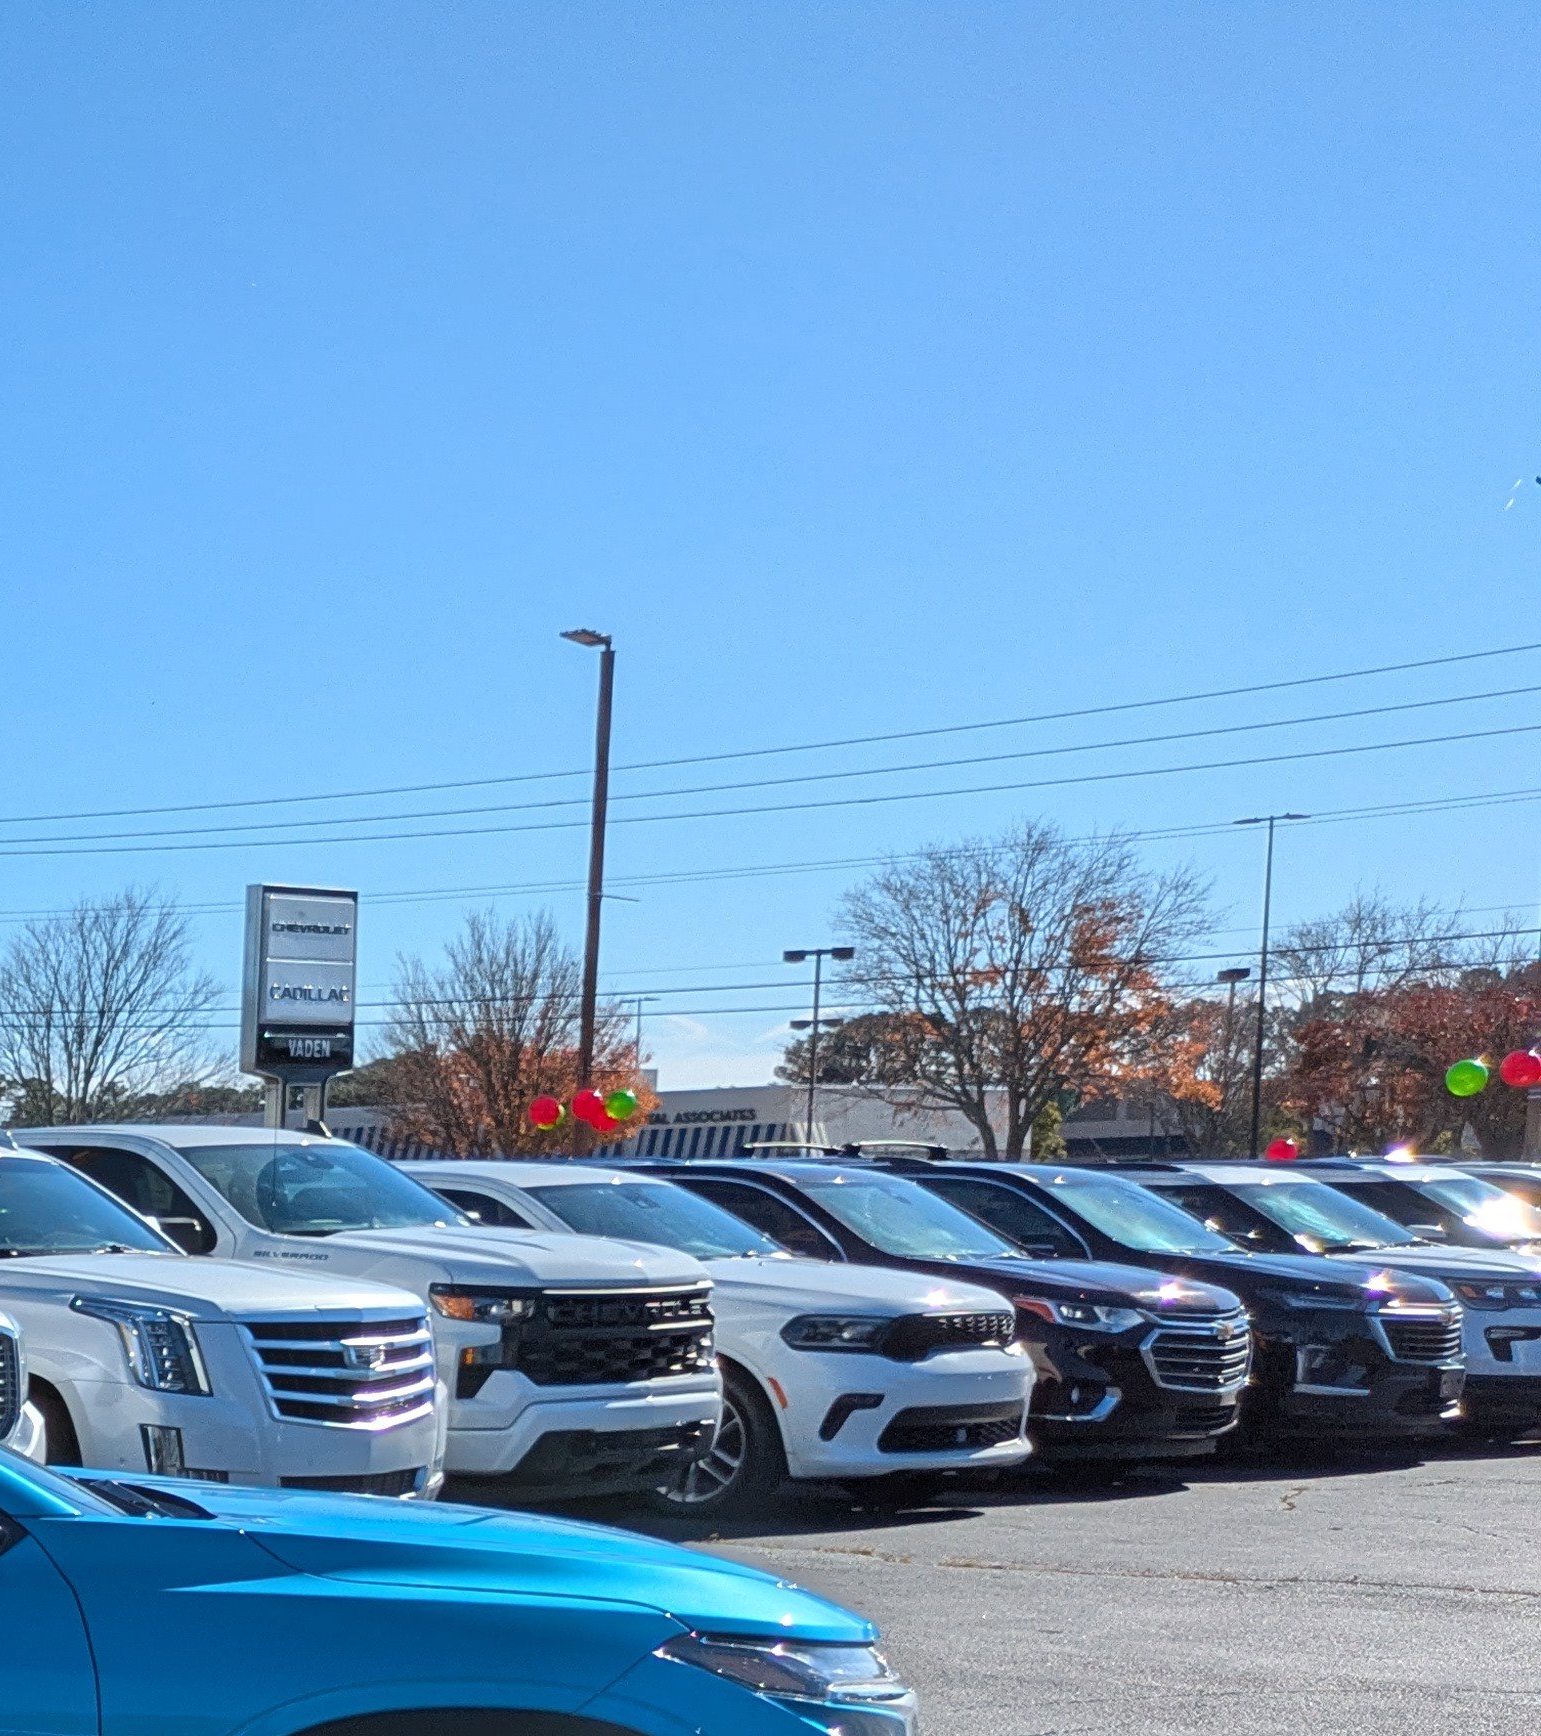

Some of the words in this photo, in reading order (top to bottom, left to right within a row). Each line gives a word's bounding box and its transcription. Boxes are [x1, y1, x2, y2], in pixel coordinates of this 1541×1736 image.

[272, 922, 351, 935] CHEVROLET
[270, 983, 350, 1002] CADILLAC
[288, 1039, 331, 1058] VADEN
[672, 1108, 756, 1124] ASSOCIATES
